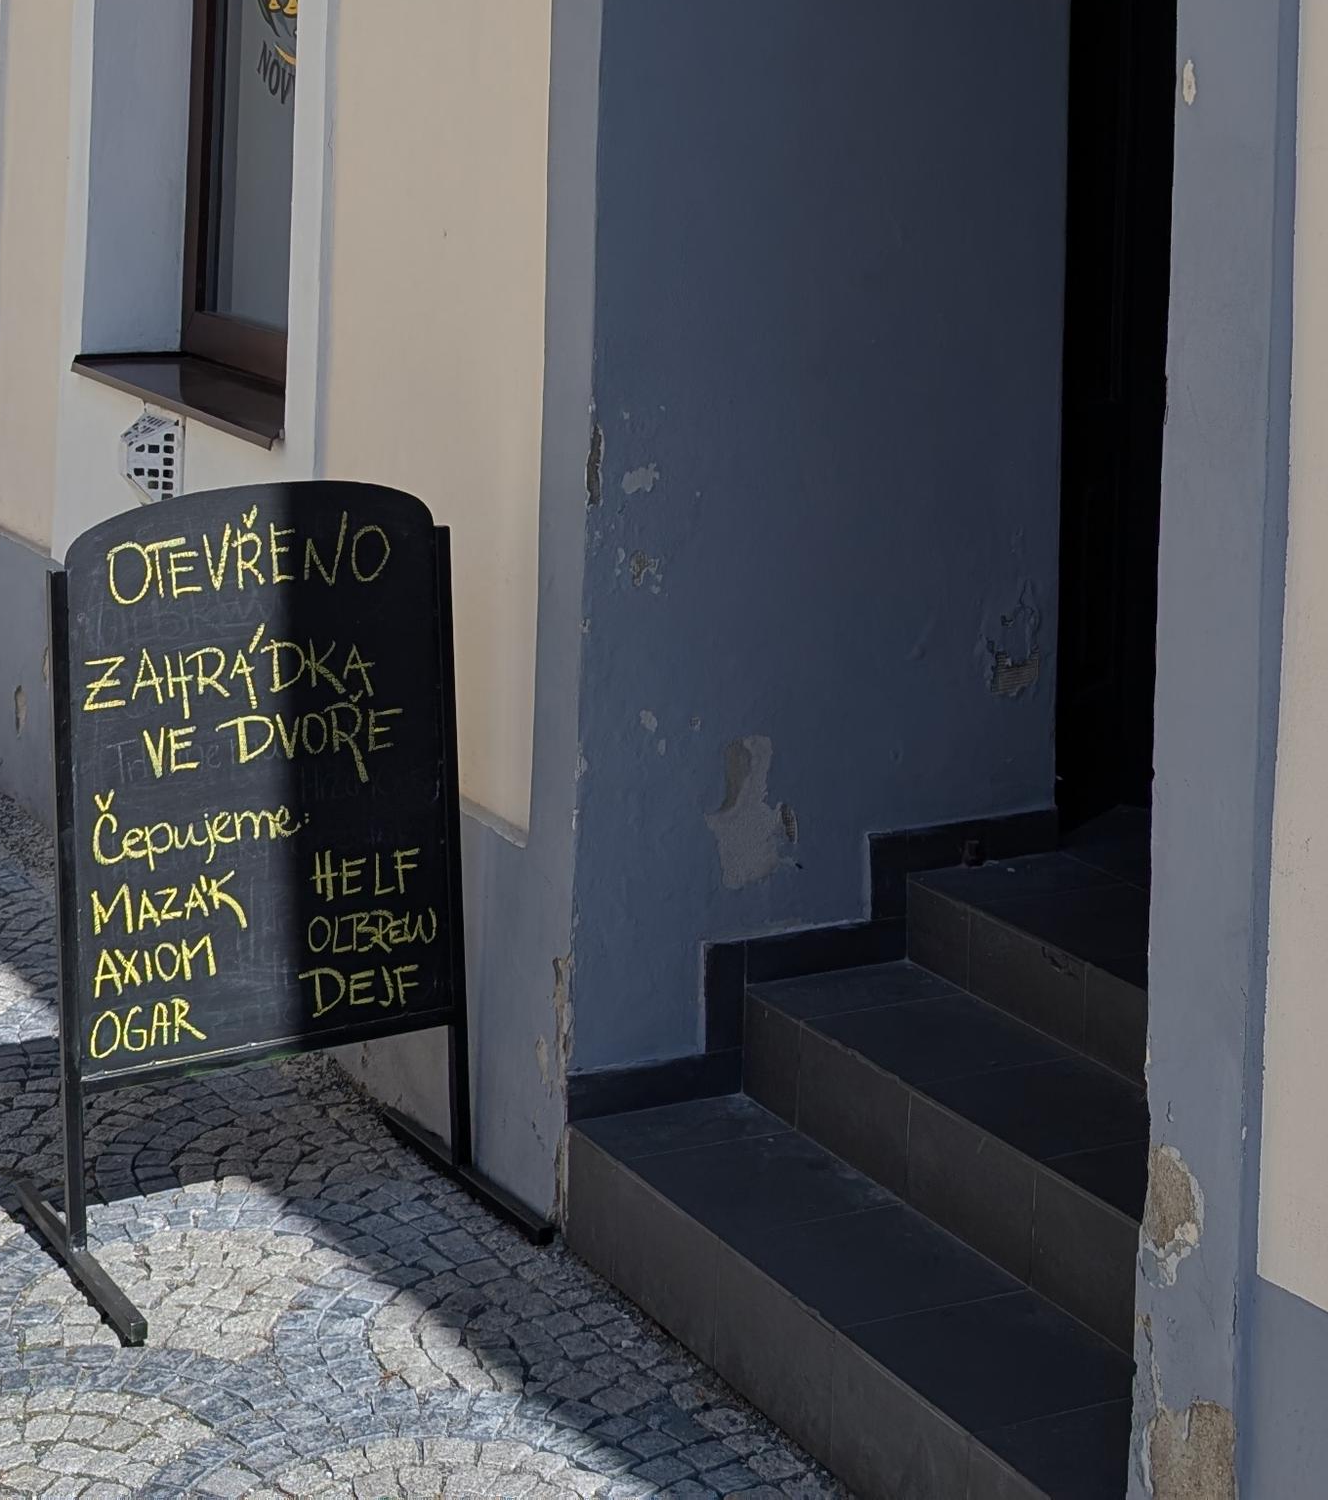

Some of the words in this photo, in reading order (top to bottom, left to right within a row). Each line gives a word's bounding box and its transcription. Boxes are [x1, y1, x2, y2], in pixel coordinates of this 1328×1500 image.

[257, 39, 296, 105] NOV
[106, 504, 391, 605] OTEVŘENO
[82, 622, 375, 720] ZAHRÁDKA
[143, 725, 202, 779] VE
[215, 690, 404, 783] DVOŘE
[309, 847, 421, 902] HELF
[93, 933, 218, 999] AXIOM
[298, 963, 421, 1019] DEJF
[89, 998, 208, 1059] OGAR
